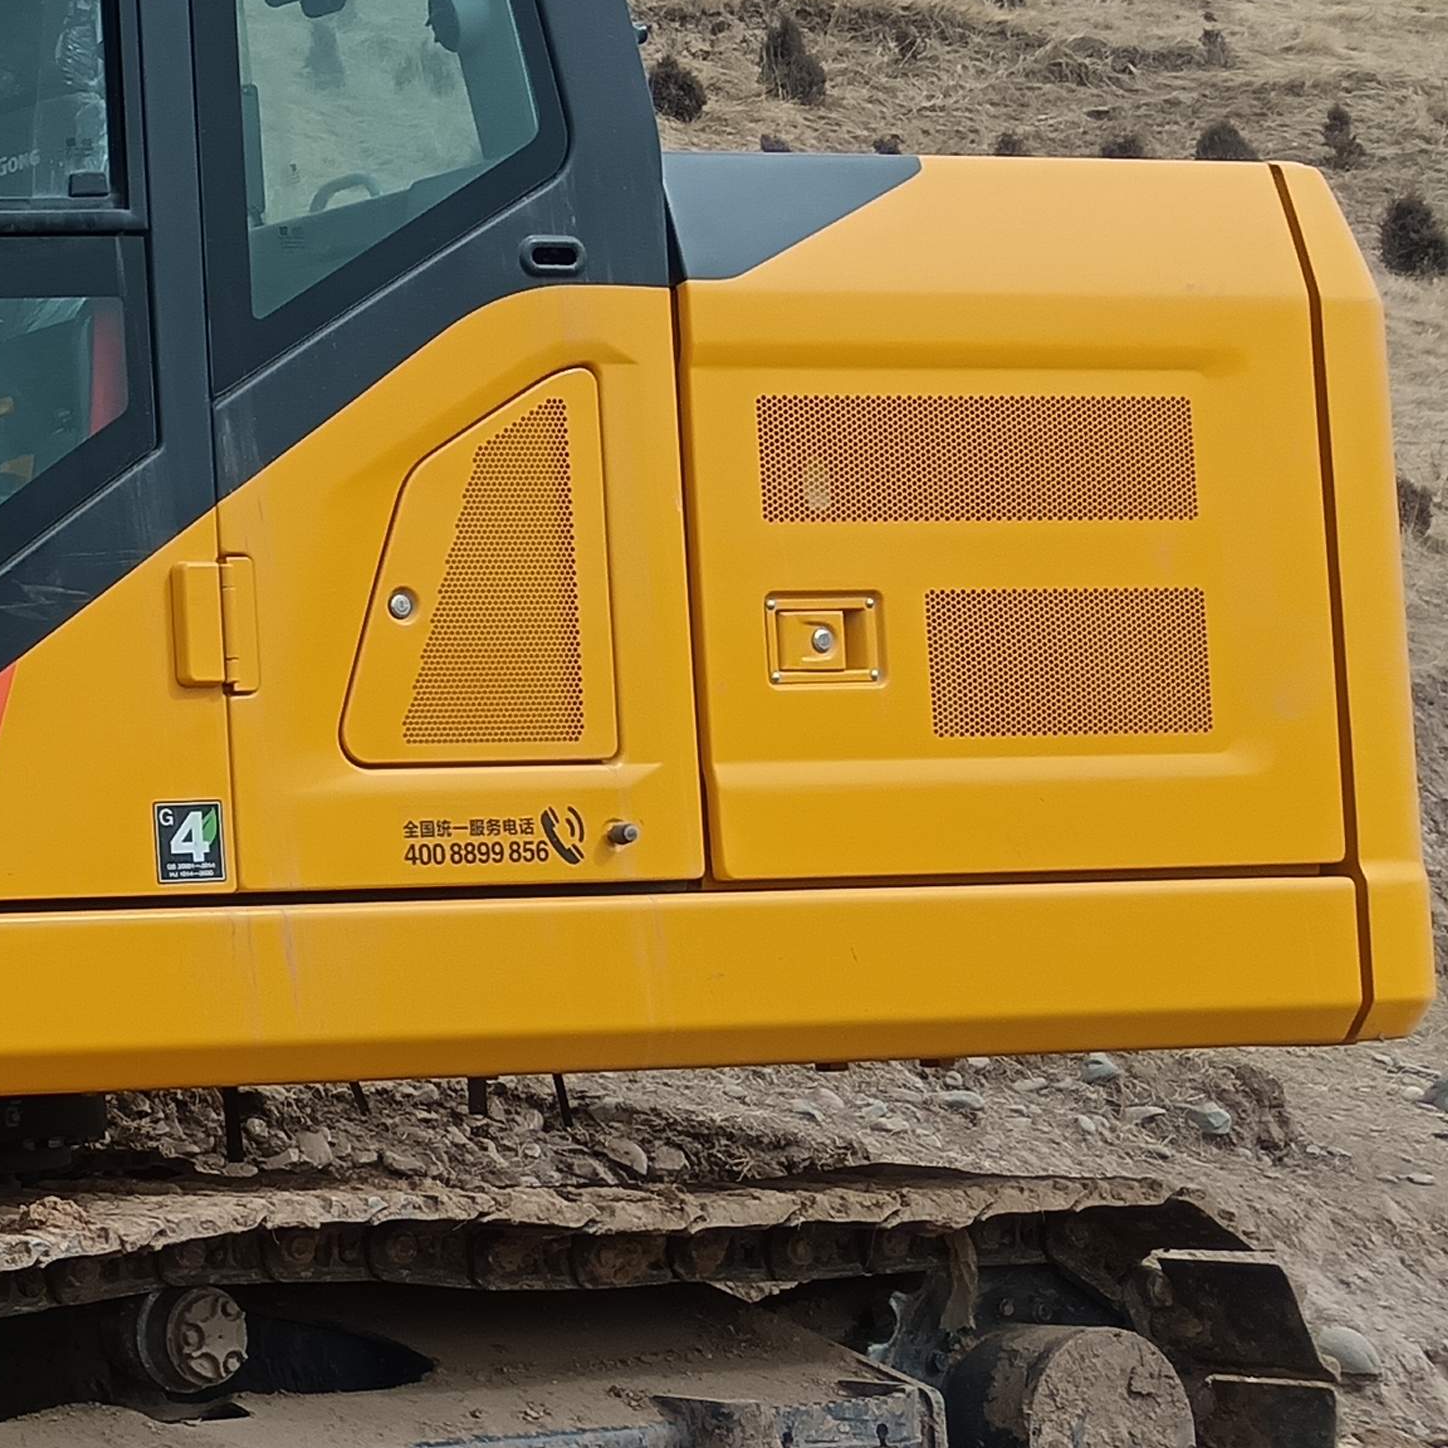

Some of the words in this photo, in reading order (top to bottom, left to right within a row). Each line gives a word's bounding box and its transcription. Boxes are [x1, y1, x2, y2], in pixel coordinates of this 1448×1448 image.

[158, 808, 175, 827] G
[402, 818, 536, 839] 全国统一服务电话
[169, 810, 211, 863] 4
[404, 843, 446, 866] 400
[449, 841, 505, 865] 8899
[507, 839, 550, 863] 856
